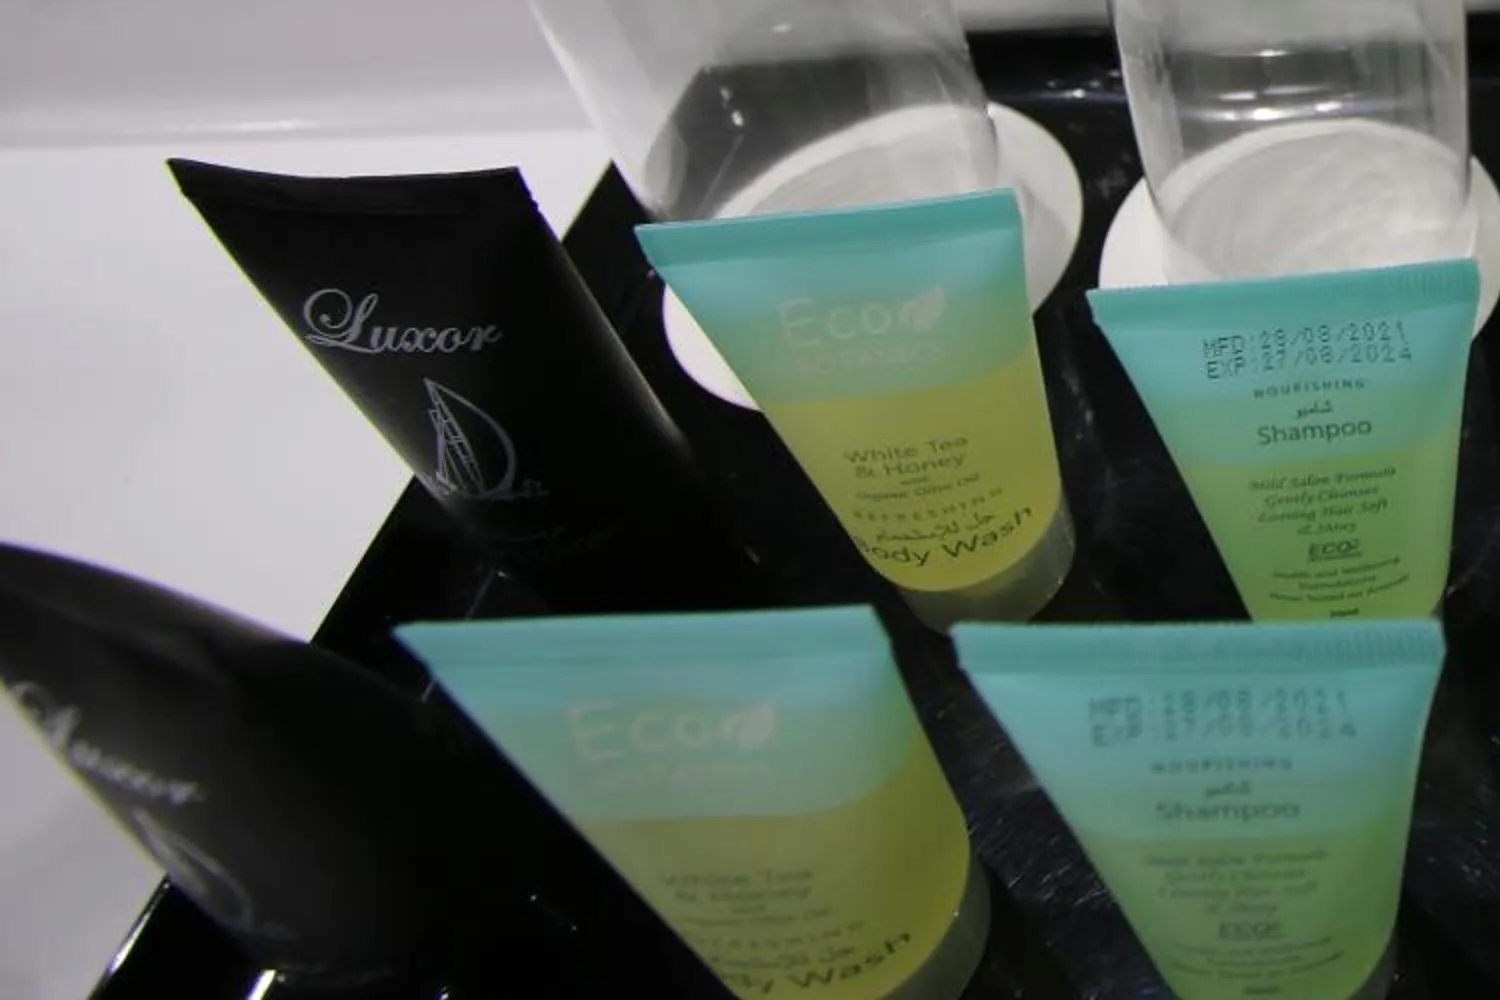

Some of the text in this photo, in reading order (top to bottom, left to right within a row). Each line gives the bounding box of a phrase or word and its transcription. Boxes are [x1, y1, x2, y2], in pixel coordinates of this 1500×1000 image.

[304, 288, 503, 354] Luxor
[777, 297, 893, 349] Eco
[1252, 378, 1366, 399] NOURISHING
[1256, 420, 1373, 446] Shampoo
[843, 437, 969, 463] White Tea
[884, 454, 965, 476] Honey
[942, 506, 1033, 559] Wash
[565, 698, 714, 761] Eco
[1154, 802, 1301, 823] Shampoo
